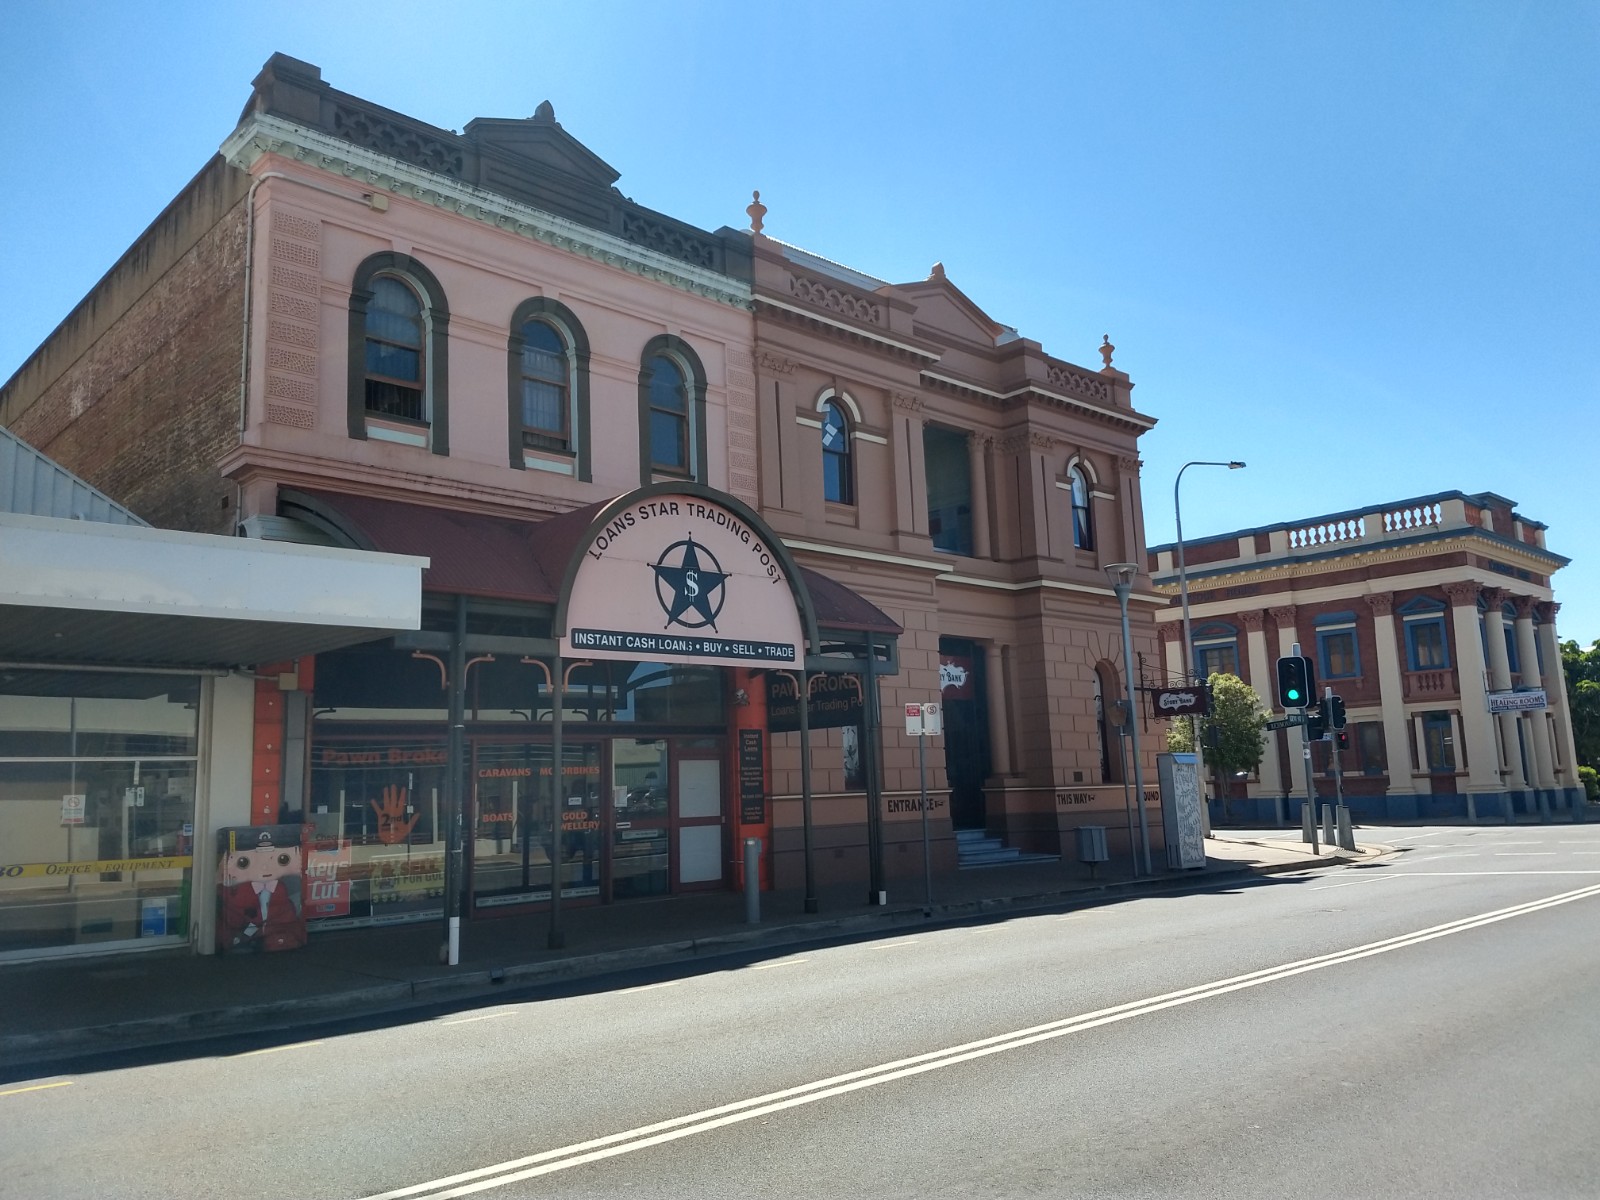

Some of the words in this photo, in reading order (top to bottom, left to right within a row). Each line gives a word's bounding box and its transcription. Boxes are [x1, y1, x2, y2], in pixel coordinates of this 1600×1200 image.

[589, 513, 636, 560] LOANS
[638, 502, 680, 520] STAR
[686, 502, 751, 544] TRADING
[752, 544, 781, 584] POST
[574, 632, 622, 646] INSTANT
[626, 636, 655, 648] CASH
[659, 638, 692, 651] LOANS
[703, 642, 722, 653] BUY
[732, 644, 756, 656] SELL
[765, 646, 794, 657] TRADE
[1520, 695, 1544, 704] ROOMS
[771, 704, 795, 716] Loans
[816, 698, 848, 713] Trading
[322, 748, 380, 766] Pawn
[479, 767, 531, 778] CARAVANS
[540, 766, 600, 776] MOORBIKES
[888, 798, 934, 812] ENTRANE
[1056, 794, 1072, 805] THIS
[1073, 793, 1088, 804] WAY
[382, 814, 402, 826] 2nd
[482, 812, 514, 822] BOATS
[562, 812, 588, 820] GOLD
[46, 864, 91, 875] OFFICE
[104, 860, 174, 872] EQUIPMENT
[425, 872, 444, 882] GOL
[312, 880, 341, 900] Cut
